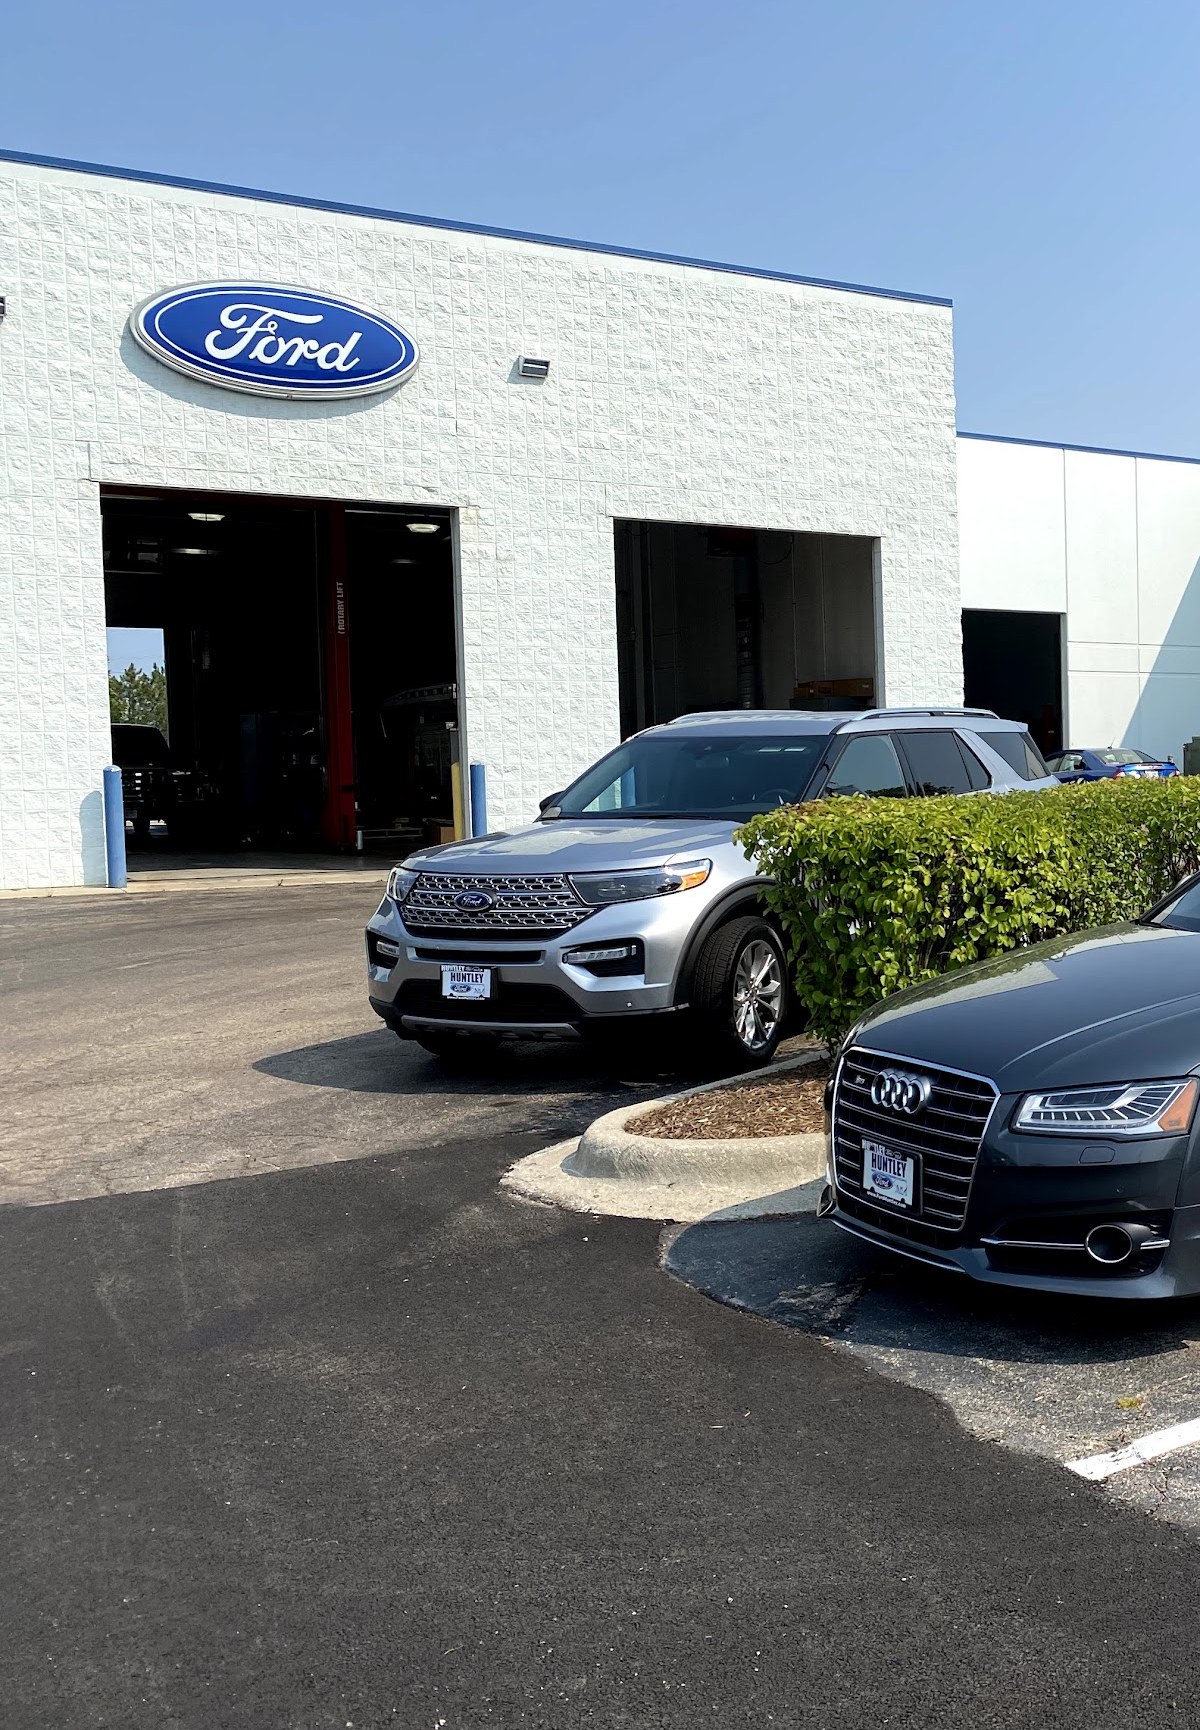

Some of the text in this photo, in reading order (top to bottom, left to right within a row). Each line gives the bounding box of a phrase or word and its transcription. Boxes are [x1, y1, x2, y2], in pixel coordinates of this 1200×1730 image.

[205, 303, 363, 372] Ford
[336, 582, 345, 630] ROTARY LIFT
[461, 895, 482, 906] Ford
[450, 972, 484, 984] HUNTLEY
[871, 1152, 907, 1178] HUNTLEY
